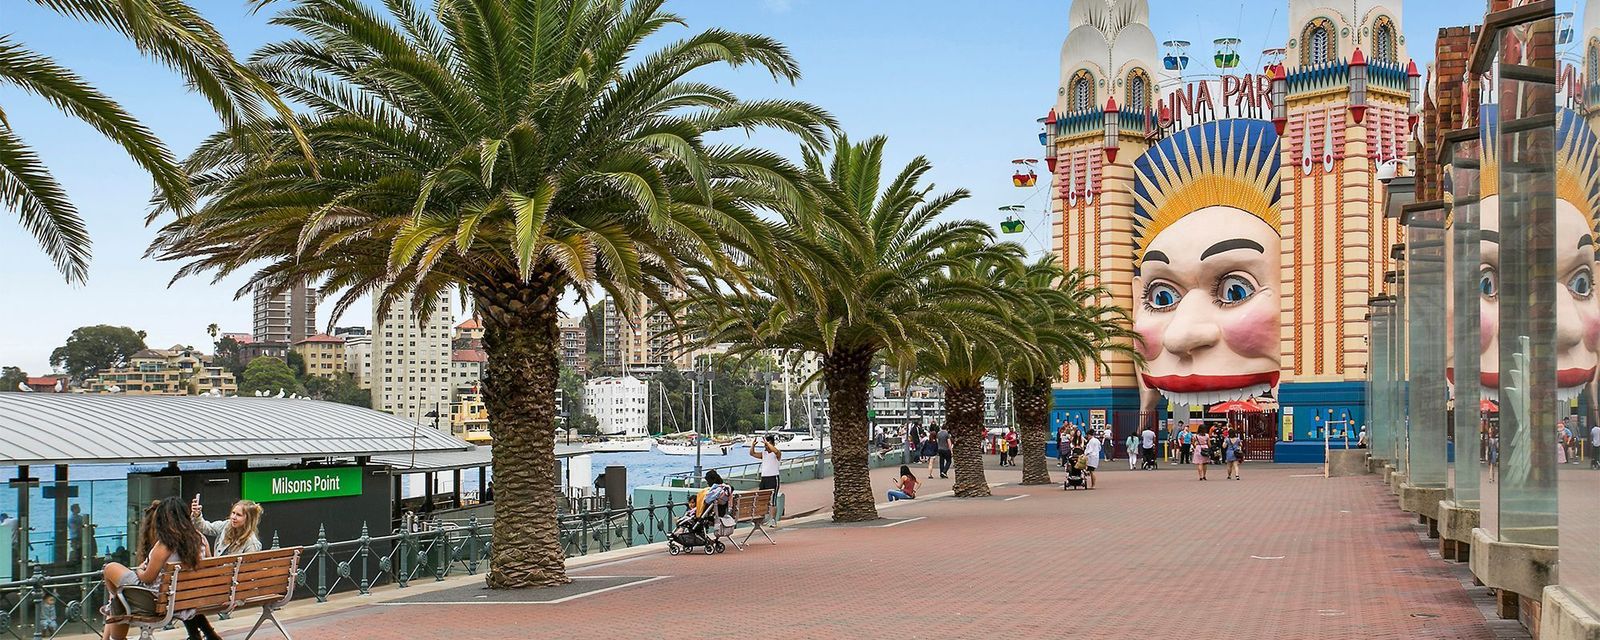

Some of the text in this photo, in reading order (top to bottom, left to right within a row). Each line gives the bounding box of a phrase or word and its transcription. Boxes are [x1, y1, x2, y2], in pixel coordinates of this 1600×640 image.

[1144, 73, 1274, 140] LUNA PAR
[272, 475, 340, 494] Milsons Point
